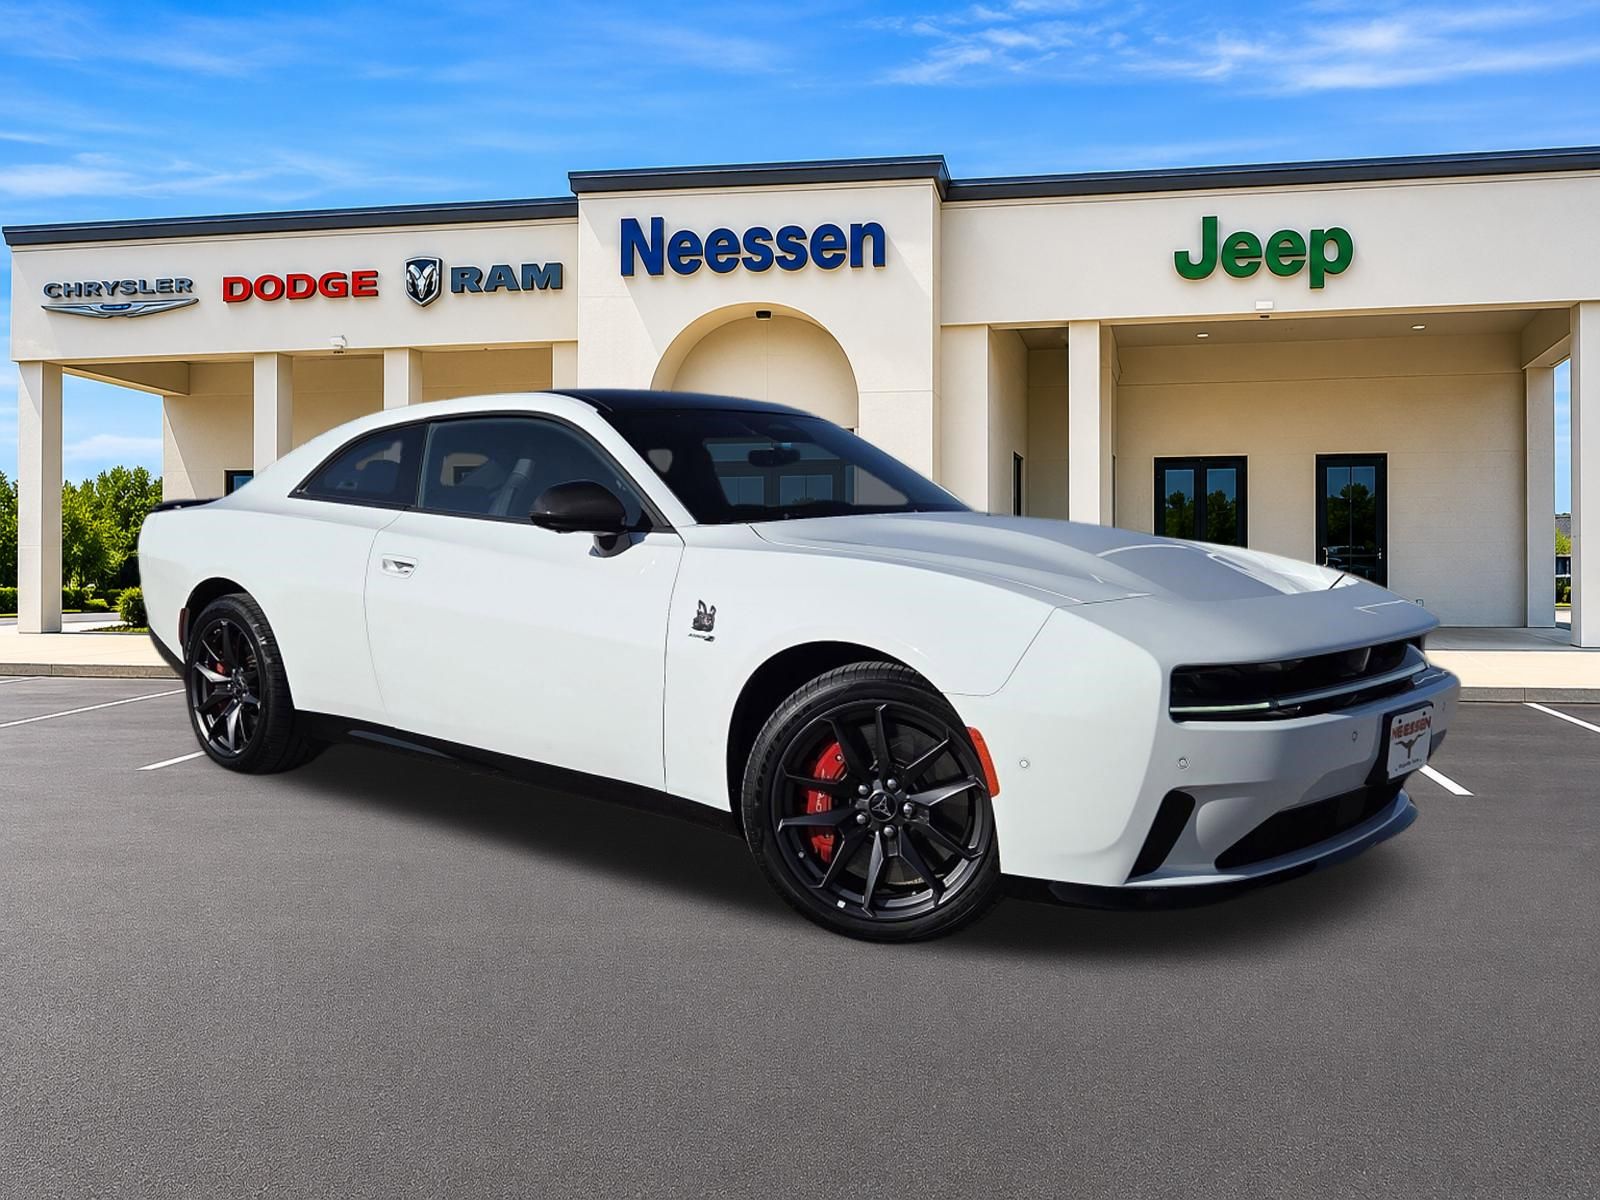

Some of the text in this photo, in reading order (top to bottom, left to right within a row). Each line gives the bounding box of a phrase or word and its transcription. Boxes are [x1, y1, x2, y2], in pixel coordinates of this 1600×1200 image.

[620, 216, 886, 277] Neessen
[1174, 215, 1354, 289] Jeep
[43, 277, 193, 299] CHRYSLER
[222, 270, 379, 303] DODGE
[450, 262, 563, 293] RAM
[1392, 715, 1431, 738] NEESSEN
